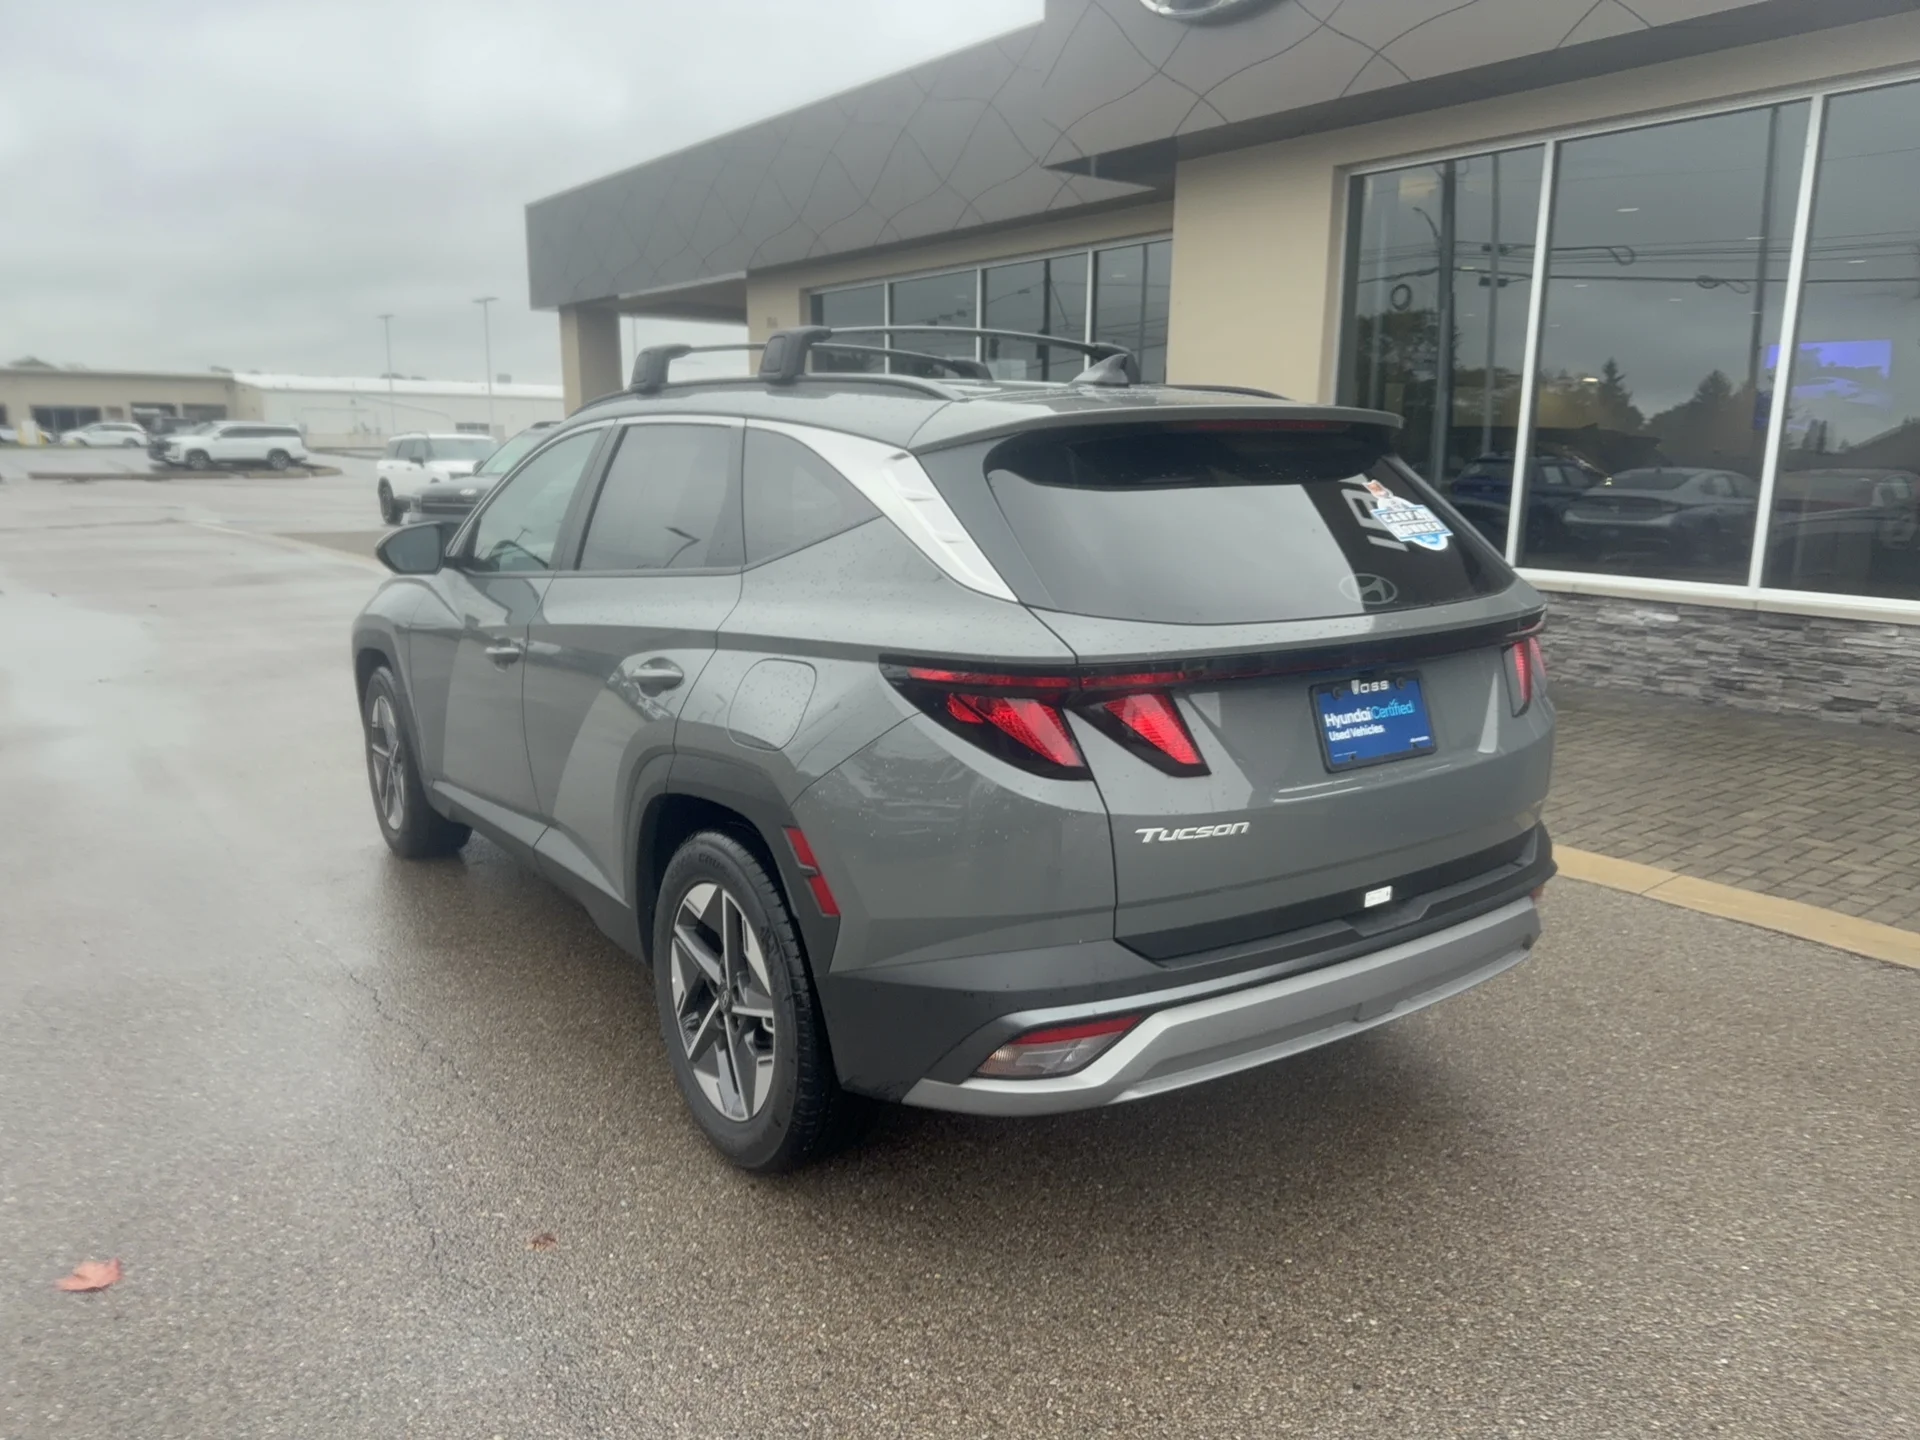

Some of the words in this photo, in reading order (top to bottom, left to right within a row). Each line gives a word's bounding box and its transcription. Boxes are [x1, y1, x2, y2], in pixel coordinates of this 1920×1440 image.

[1379, 508, 1432, 523] CARFA
[1351, 680, 1389, 695] Voss
[1328, 730, 1351, 741] Used
[1350, 724, 1385, 738] Vehicles
